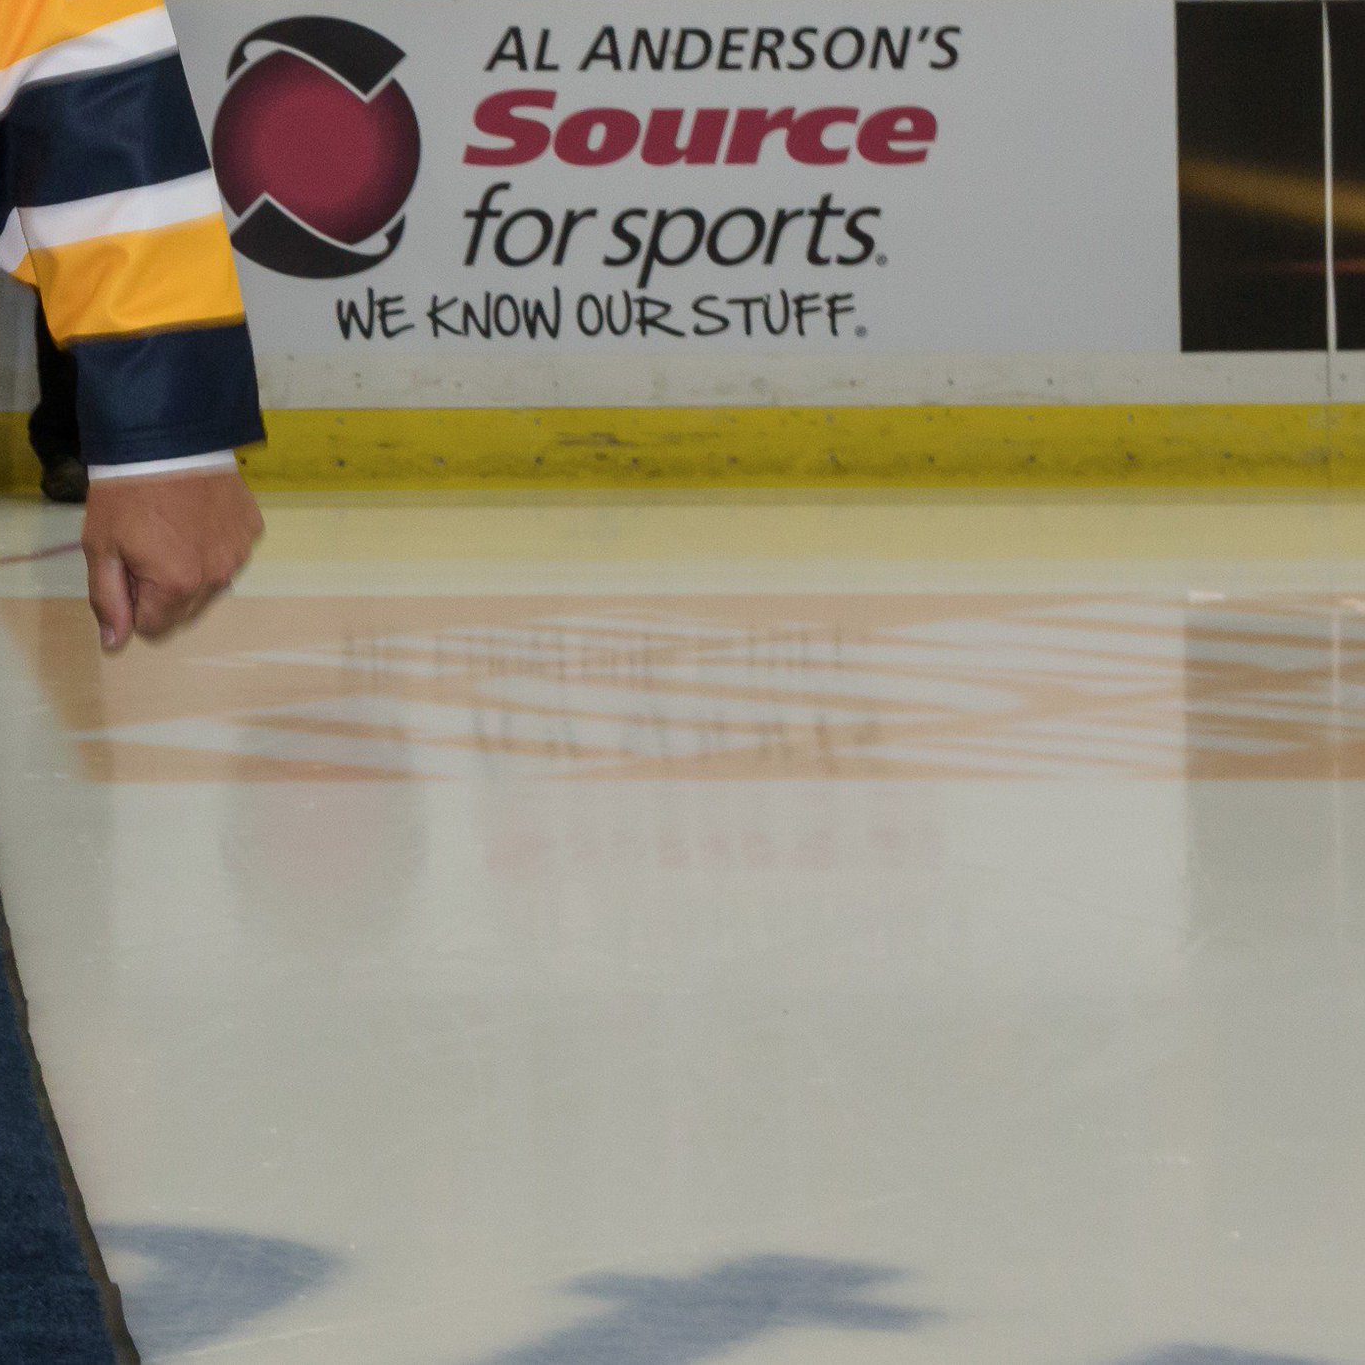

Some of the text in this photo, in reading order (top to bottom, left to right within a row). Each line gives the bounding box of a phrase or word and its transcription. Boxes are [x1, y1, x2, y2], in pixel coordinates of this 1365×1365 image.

[483, 25, 962, 73] AL ANDERSON'S
[462, 87, 939, 167] Source
[463, 181, 883, 290] for sports
[336, 286, 856, 340] WE KNOW OUR STUFF
